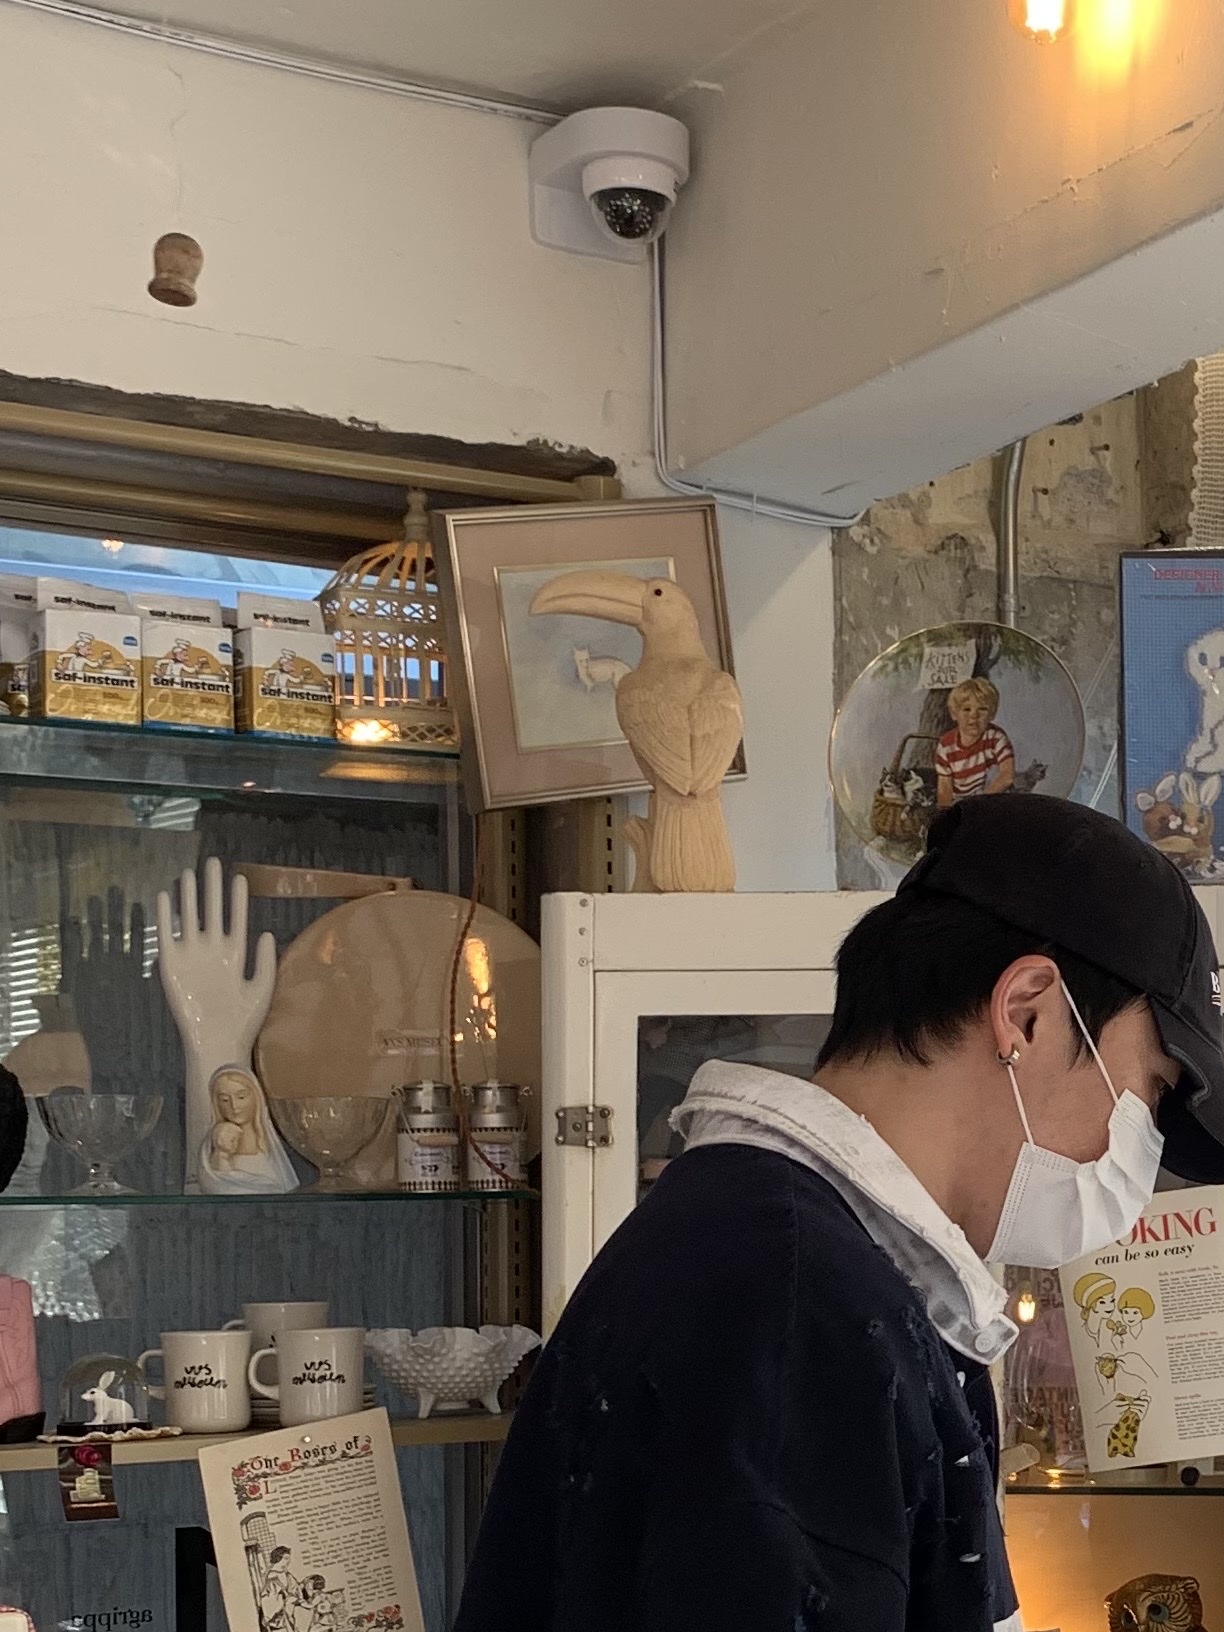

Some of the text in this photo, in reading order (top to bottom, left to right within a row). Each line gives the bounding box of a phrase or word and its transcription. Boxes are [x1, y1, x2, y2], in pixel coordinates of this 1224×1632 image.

[54, 595, 117, 612] saf-instant
[149, 609, 211, 624] saf-instant
[54, 670, 137, 688] saf-instant
[153, 676, 231, 695] saf-instant
[927, 672, 958, 687] SALE
[260, 686, 334, 704] saf-instant
[1094, 1243, 1196, 1266] can be so easy
[249, 1455, 280, 1471] The
[344, 1435, 360, 1451] of
